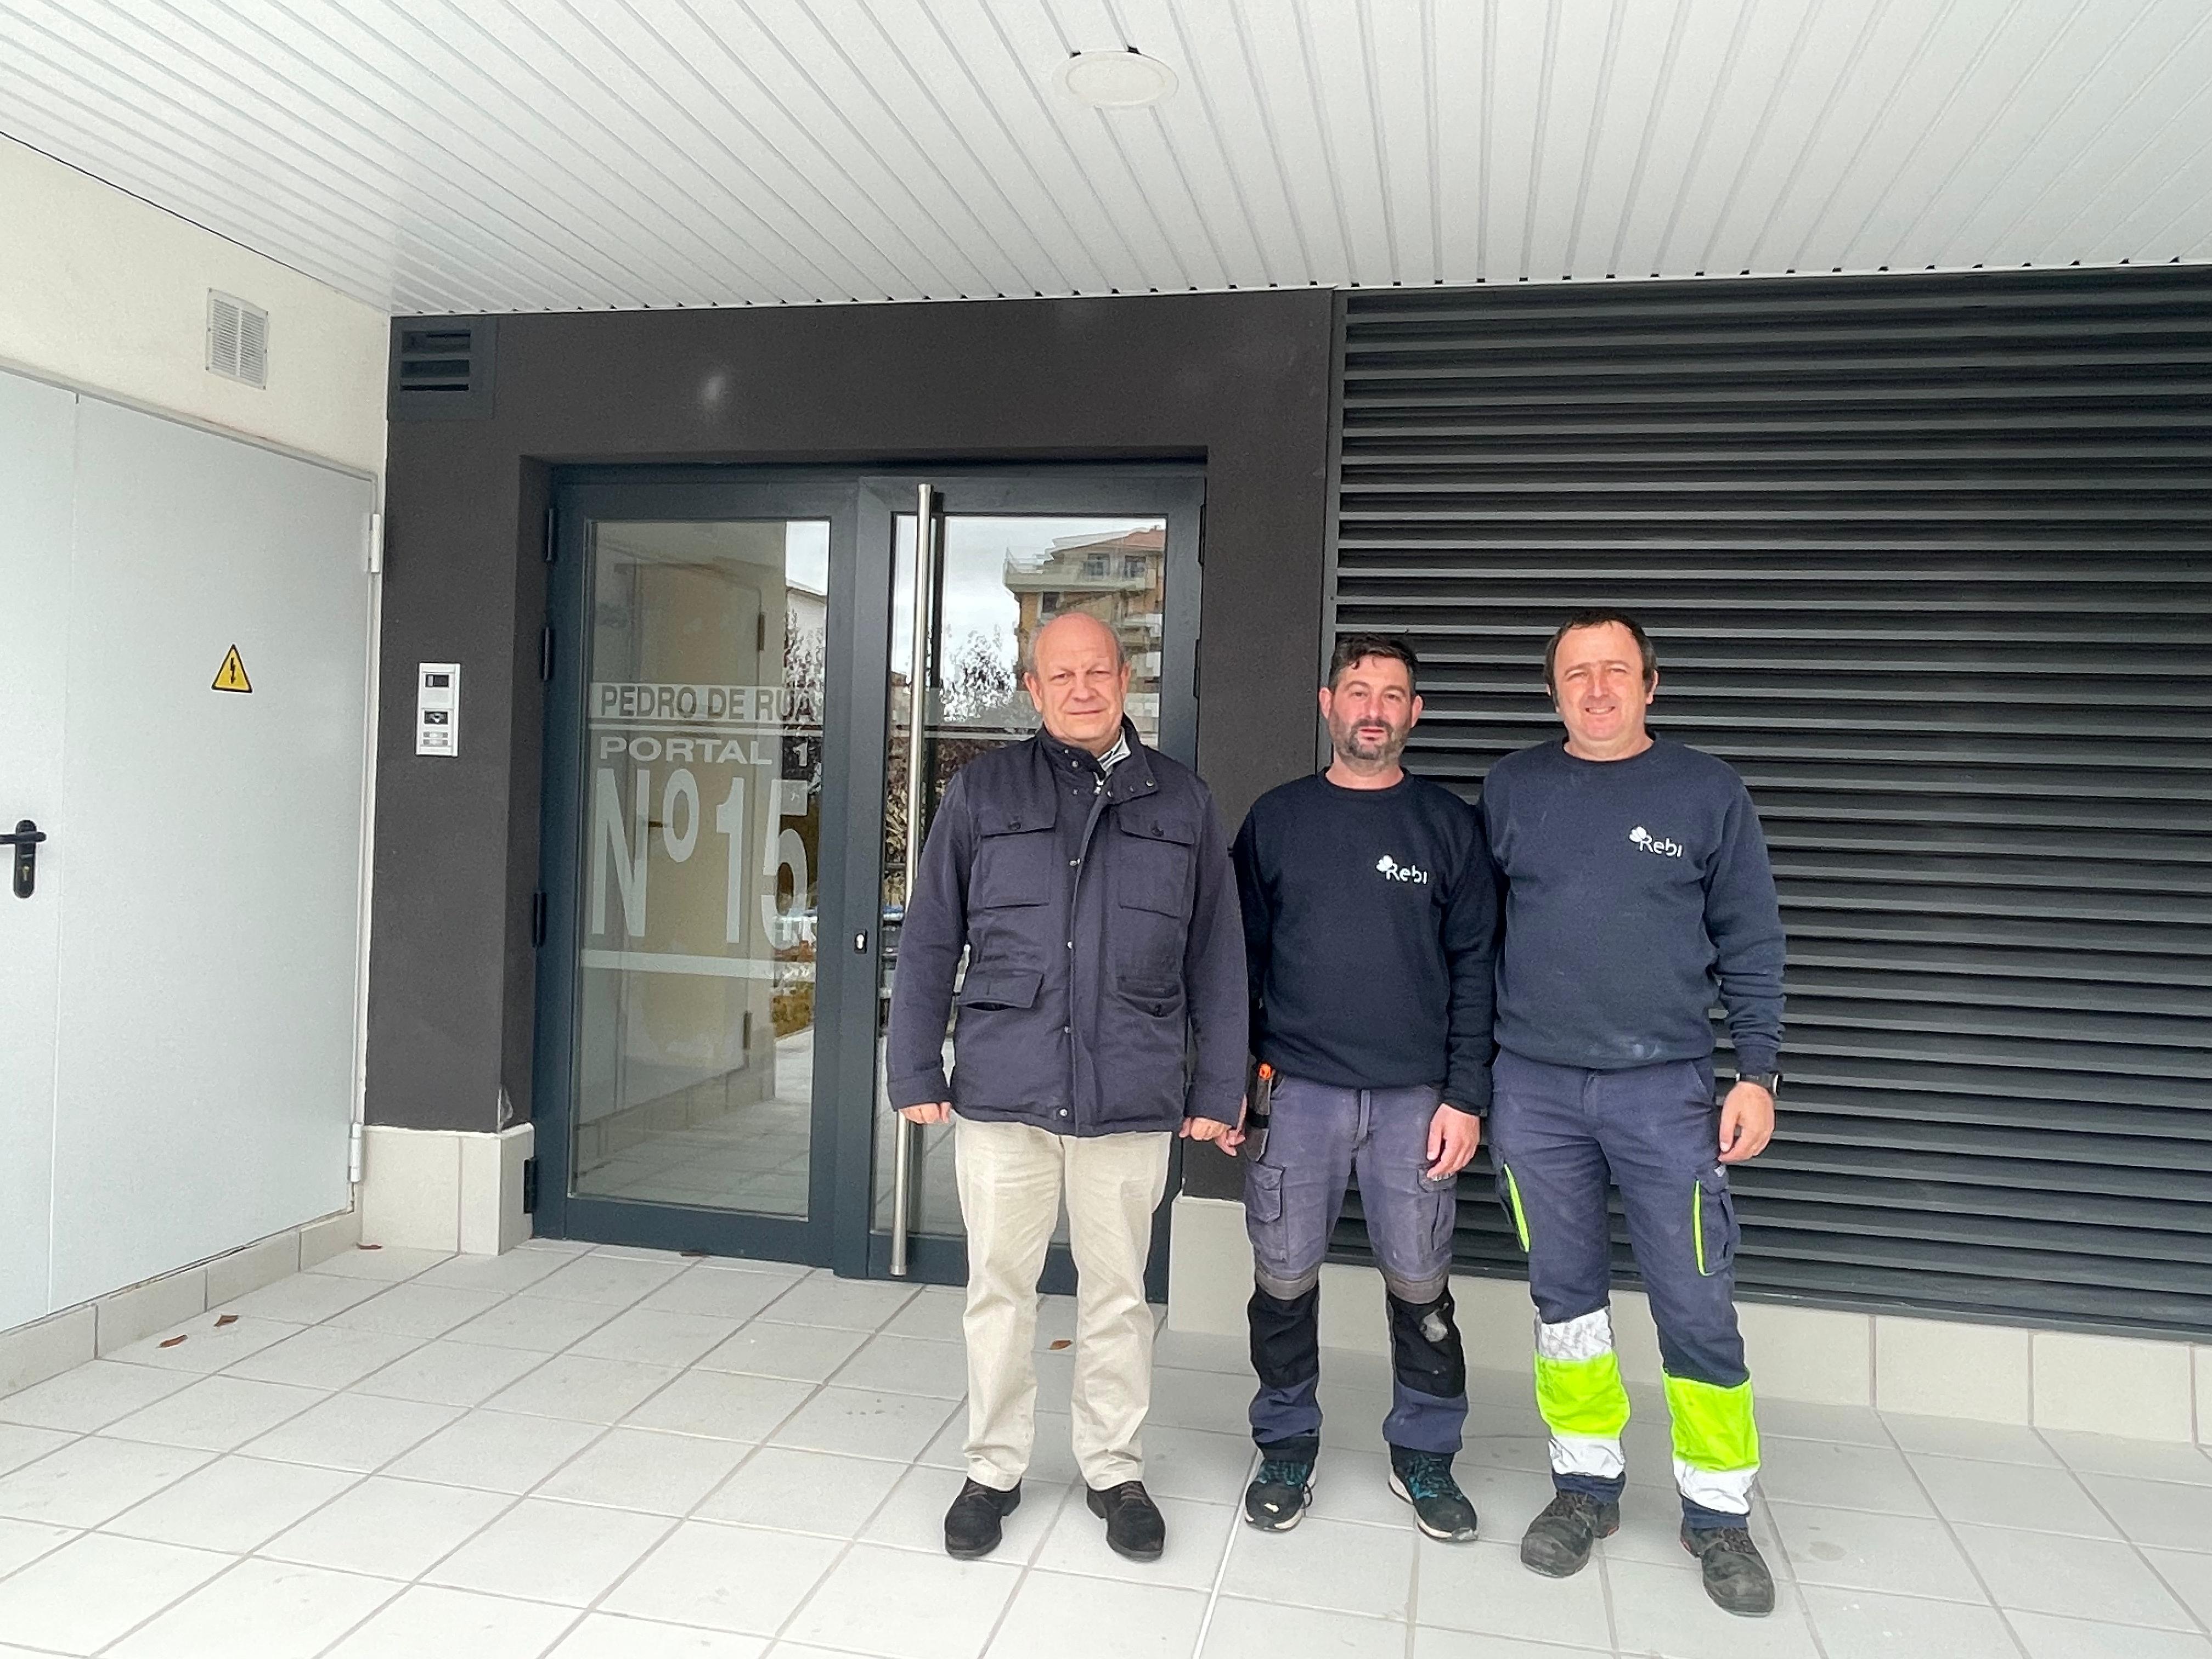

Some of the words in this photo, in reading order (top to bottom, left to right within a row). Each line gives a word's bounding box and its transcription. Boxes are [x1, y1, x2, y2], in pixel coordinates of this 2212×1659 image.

[601, 686, 697, 719] PEDRO
[708, 688, 745, 720] DE
[755, 689, 815, 722] RUA
[600, 736, 773, 765] PORTAL
[792, 742, 808, 768] 1
[1639, 835, 1683, 857] Rebi
[1386, 862, 1427, 884] Rebi
